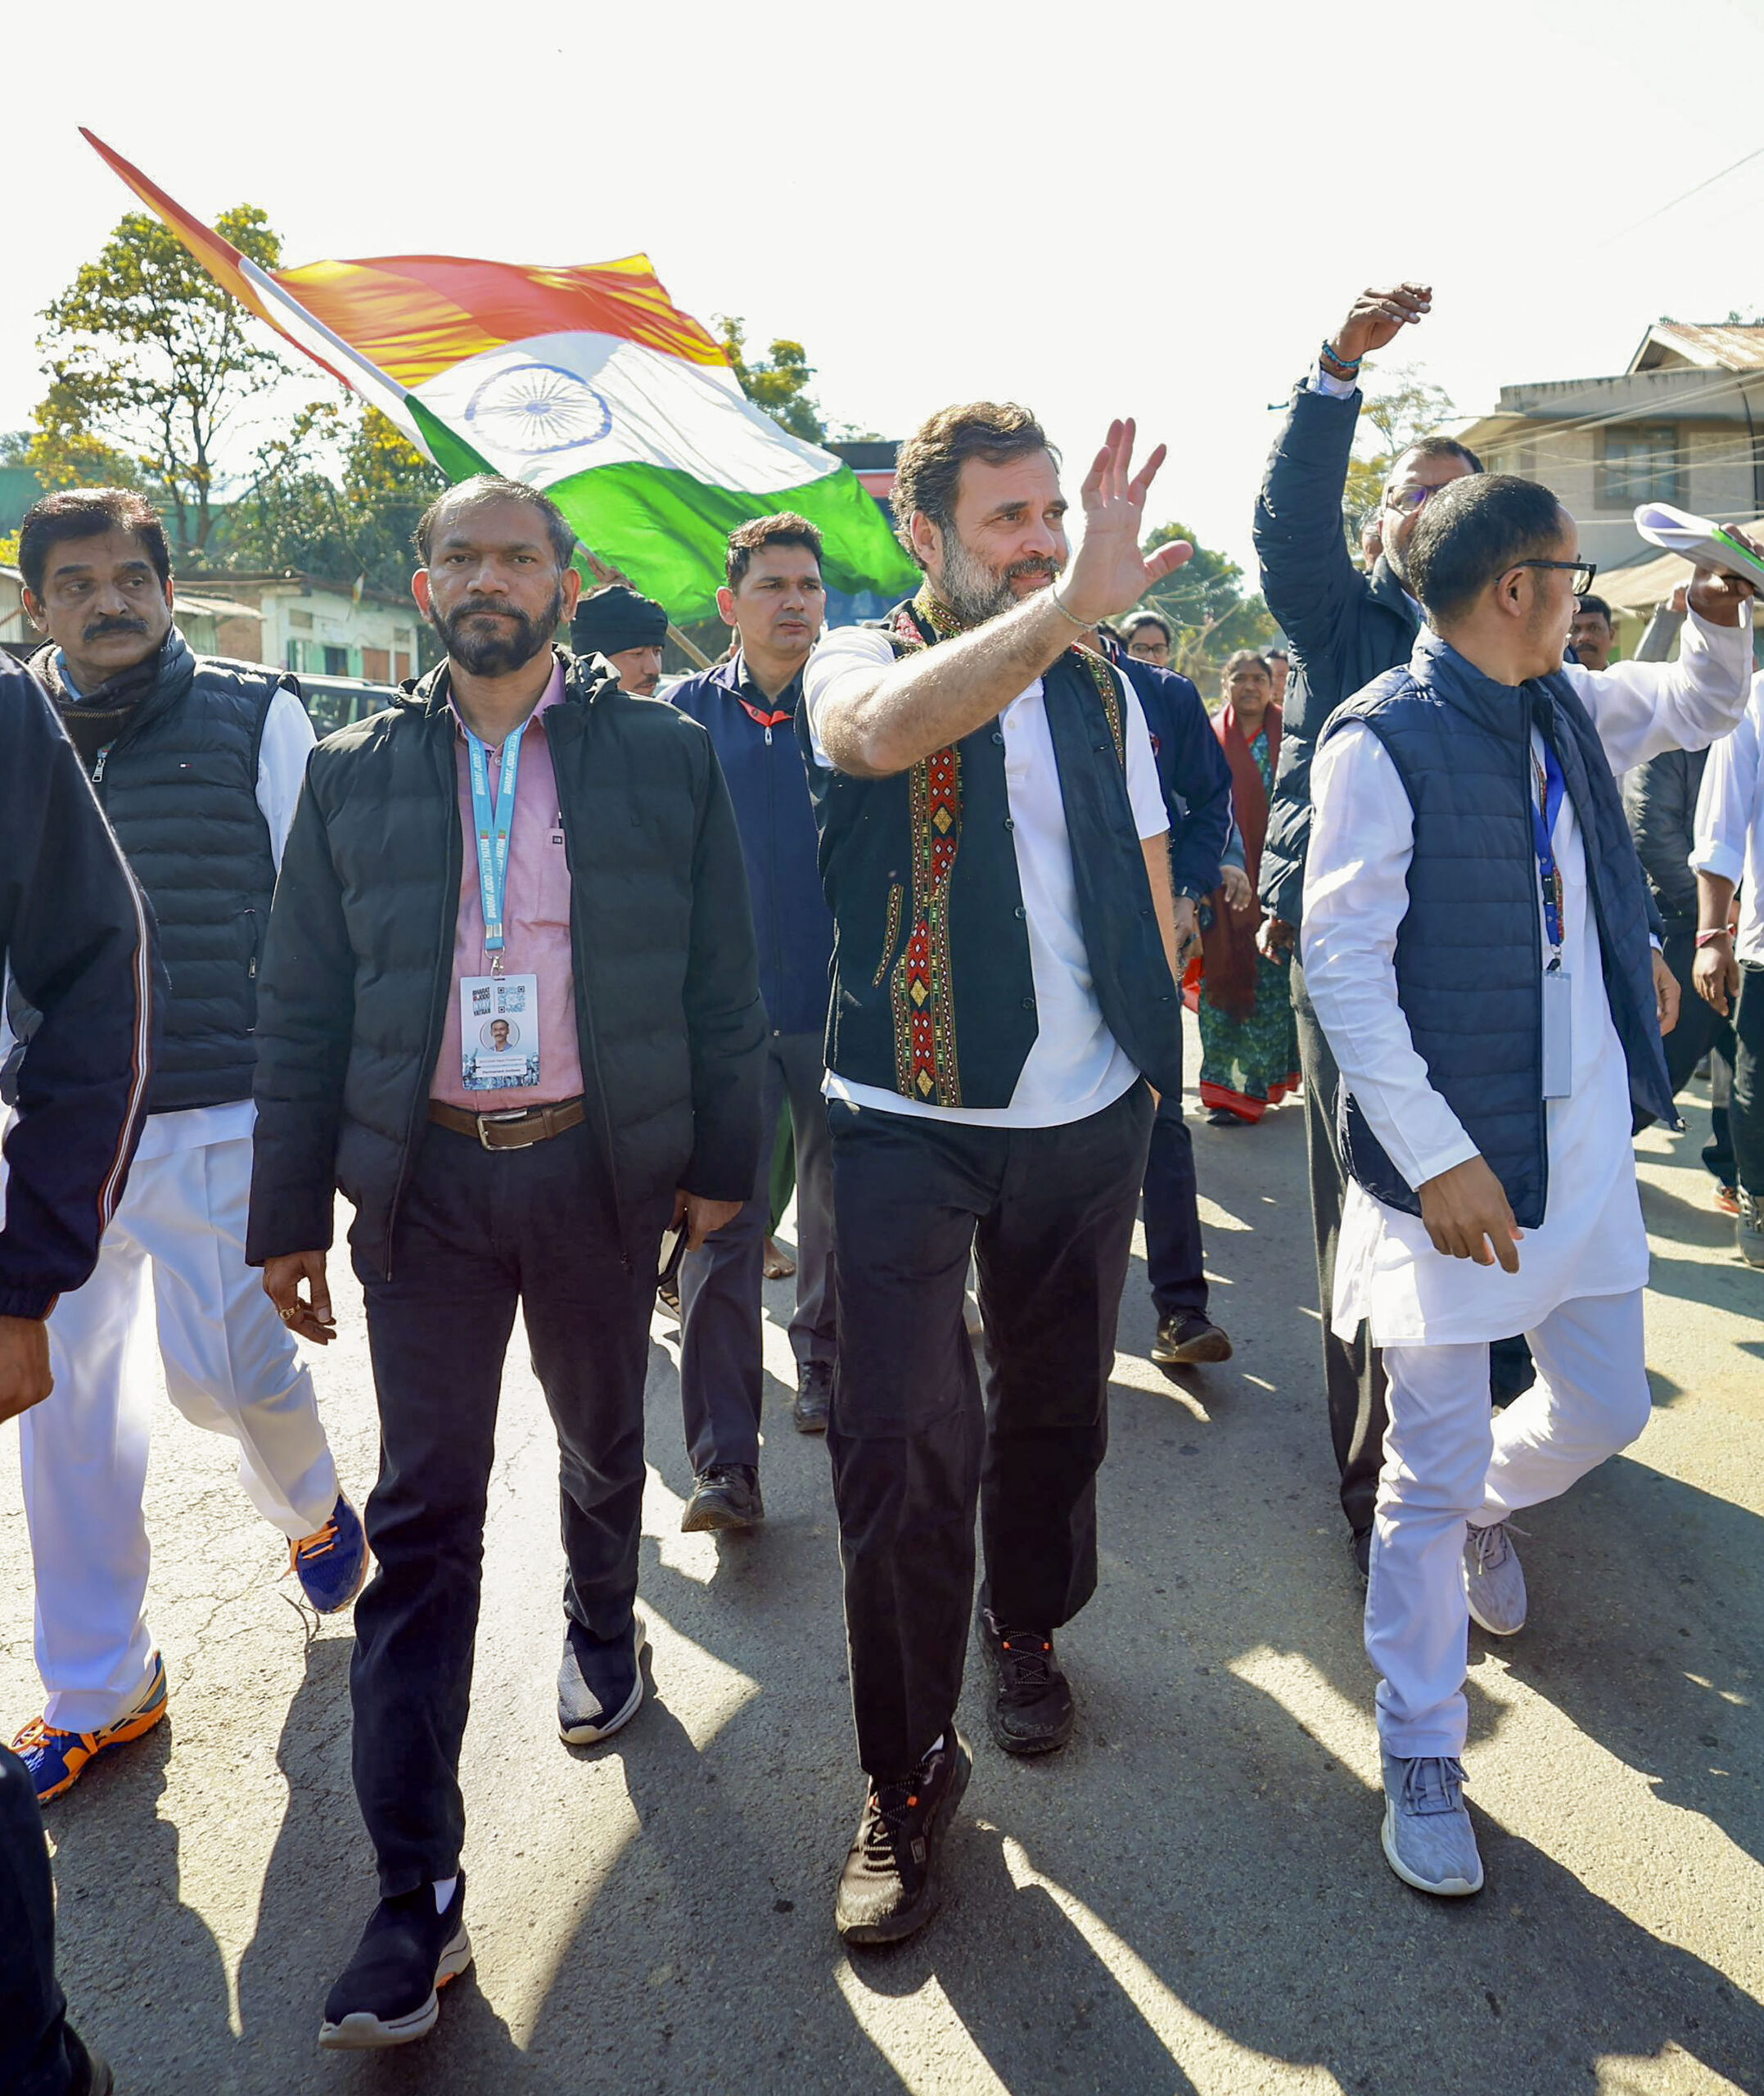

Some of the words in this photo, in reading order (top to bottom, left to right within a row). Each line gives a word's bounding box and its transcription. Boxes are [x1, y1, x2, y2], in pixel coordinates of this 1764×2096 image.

[506, 751, 515, 770] JODO
[474, 770, 485, 795] BHARAT
[503, 769, 513, 795] BHARAT
[480, 839, 491, 859] YATRA
[484, 874, 494, 893] JODO
[485, 892, 497, 919] BHARAT
[472, 987, 490, 996] BHARAT
